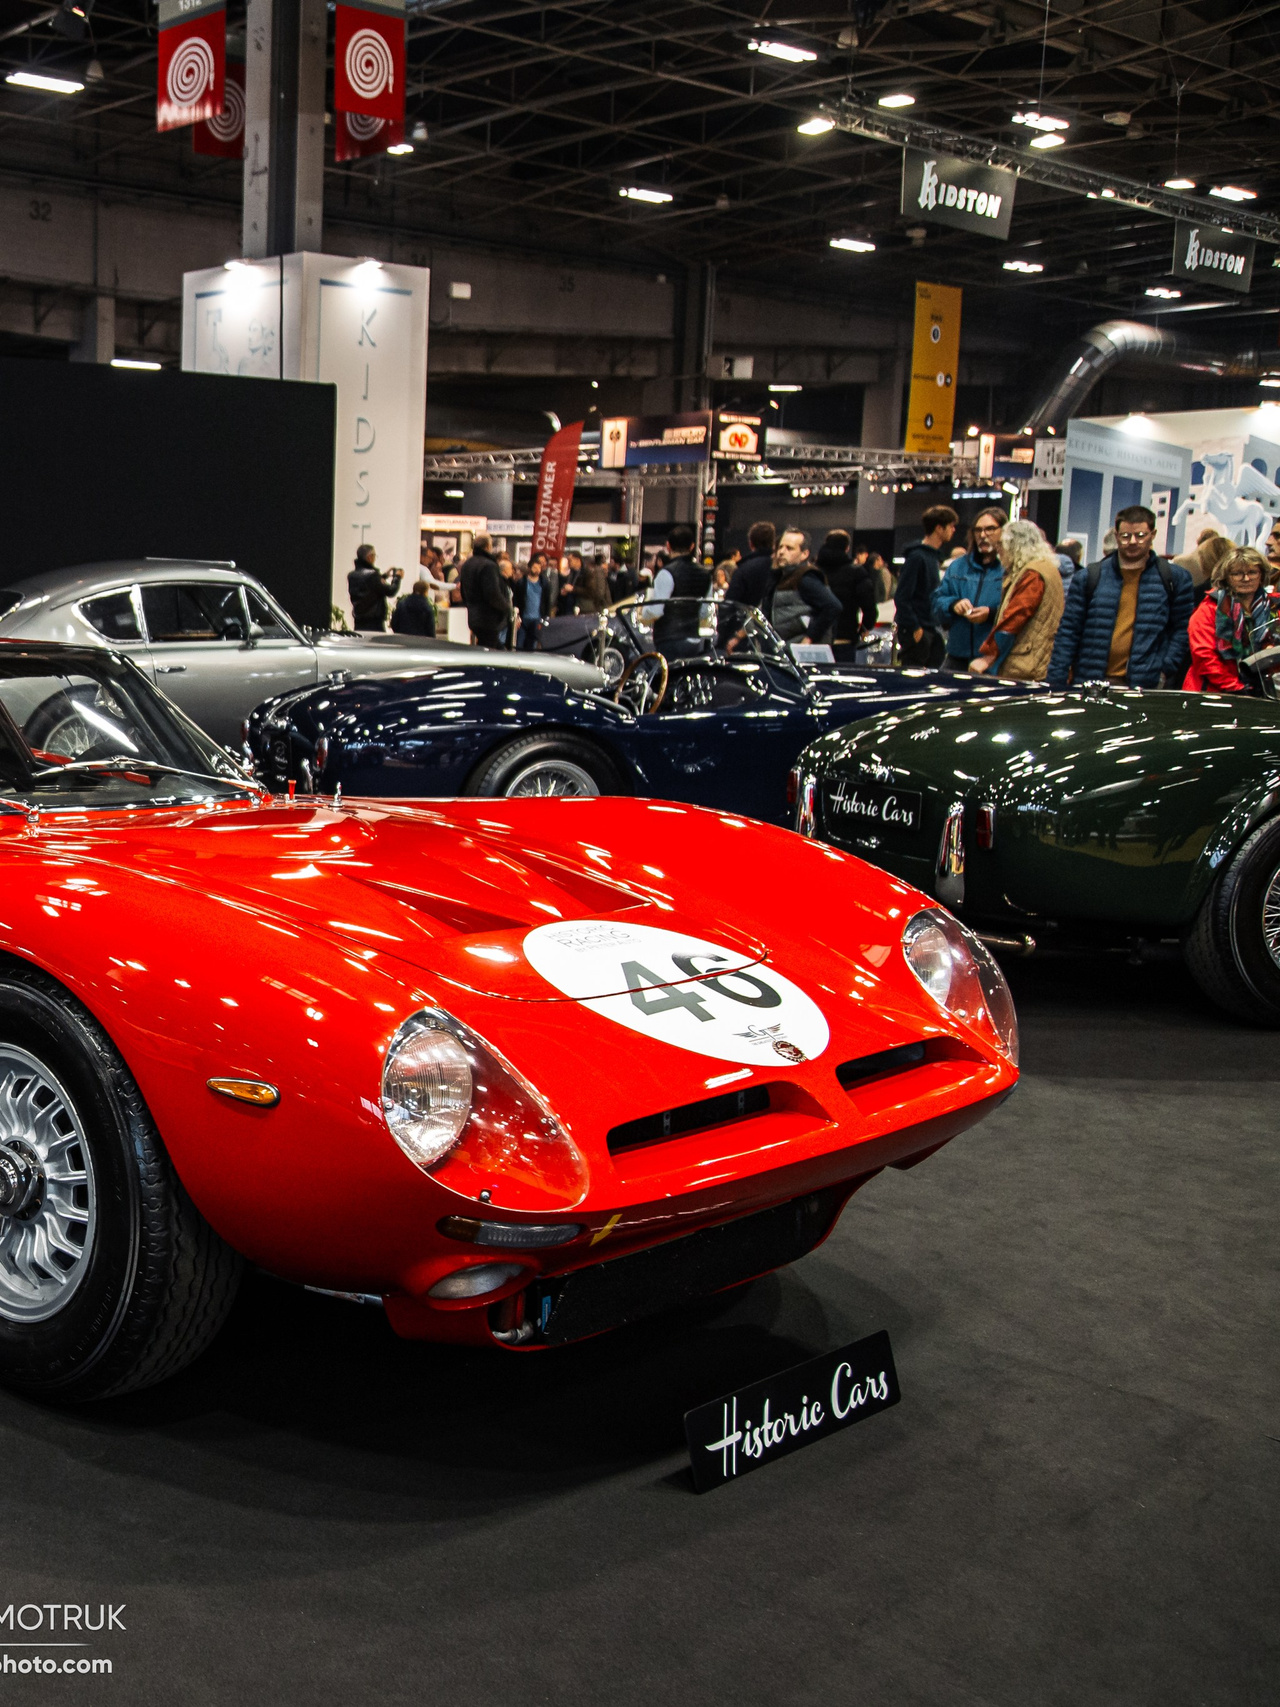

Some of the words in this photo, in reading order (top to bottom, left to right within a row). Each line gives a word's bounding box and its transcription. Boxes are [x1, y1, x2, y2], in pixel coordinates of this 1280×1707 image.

[28, 200, 53, 222] 32
[918, 160, 1002, 219] KIDSTON
[1184, 229, 1245, 275] KIDSTON
[536, 461, 557, 550] OLDTIMER
[829, 781, 879, 817] Historic
[882, 795, 914, 826] Cars
[557, 930, 631, 948] RACING
[621, 952, 782, 1023] 46
[705, 1396, 824, 1477] Historic
[831, 1362, 888, 1419] Cars
